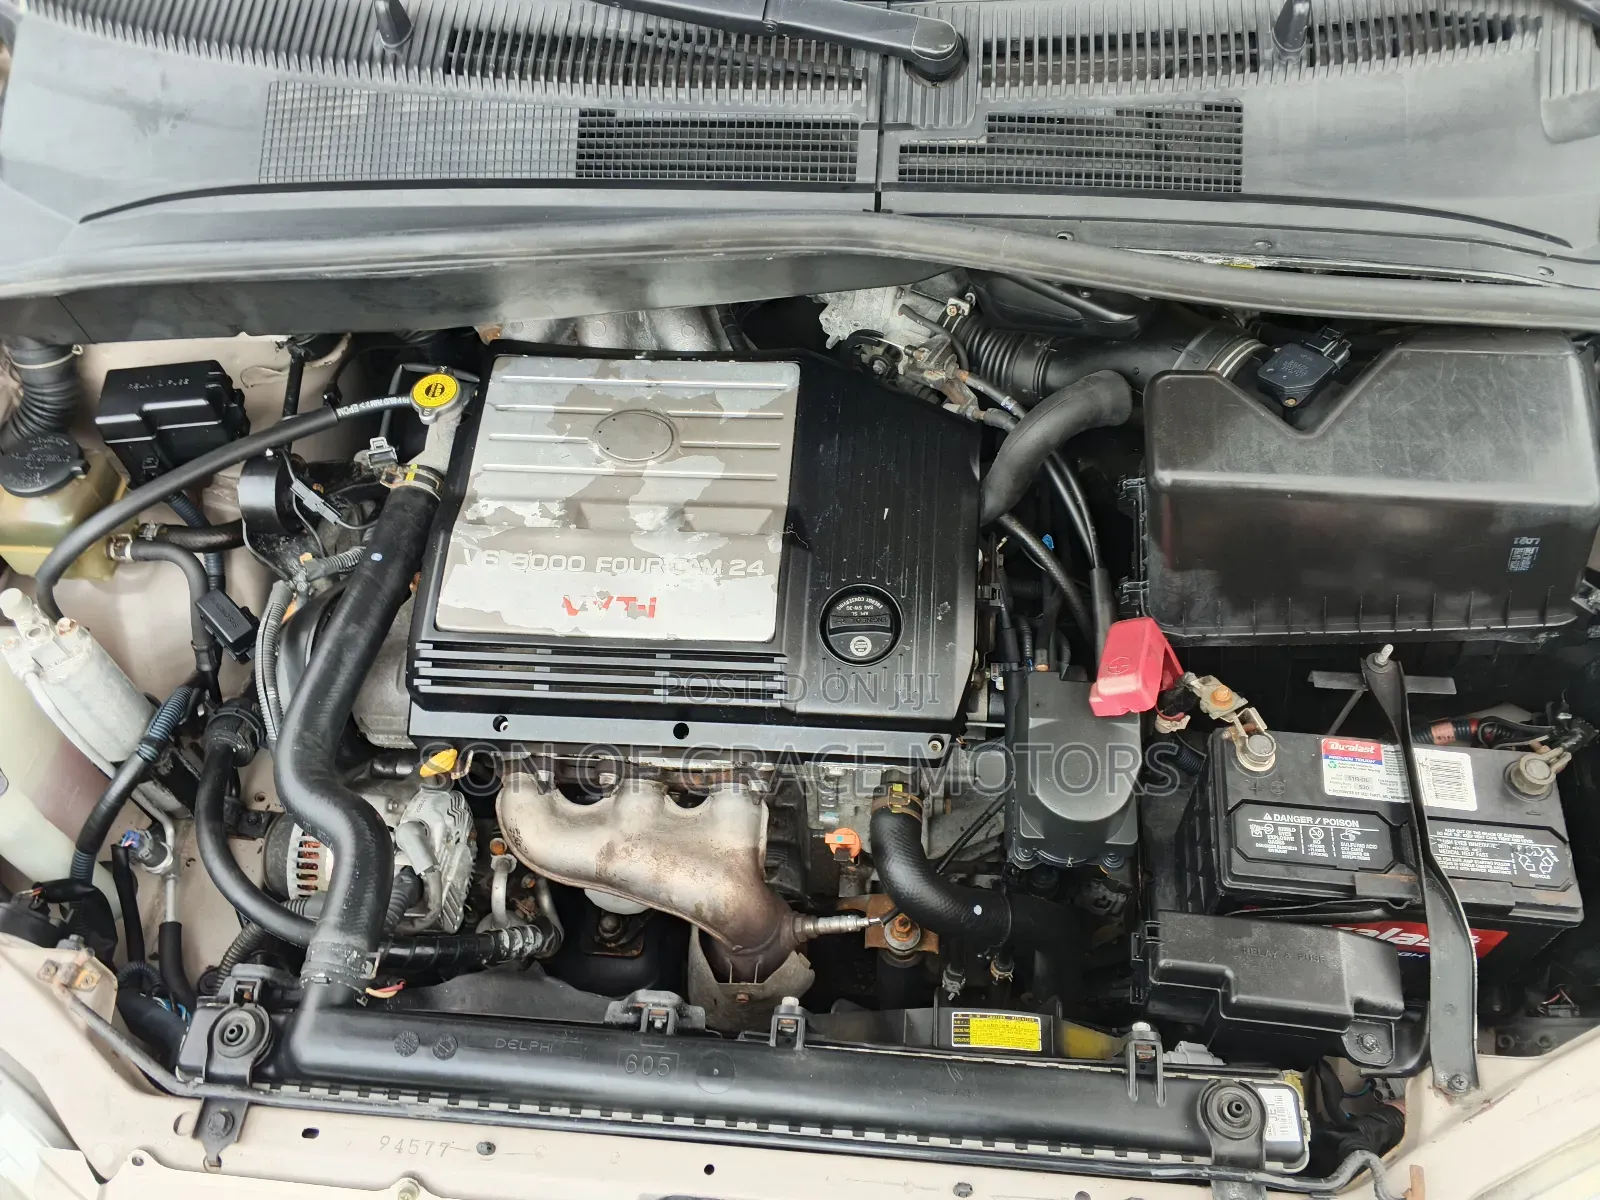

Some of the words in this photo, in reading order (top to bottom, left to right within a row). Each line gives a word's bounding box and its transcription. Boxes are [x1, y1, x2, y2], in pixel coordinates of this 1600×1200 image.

[509, 553, 586, 573] 3000
[595, 556, 665, 575] FOUR
[728, 559, 765, 577] 24
[1328, 741, 1375, 754] Duralast
[1273, 813, 1313, 824] DANGER
[1322, 818, 1360, 828] POISON
[494, 1037, 554, 1053] DELPHI
[625, 1053, 671, 1076] 605
[379, 1135, 451, 1158] 94577
